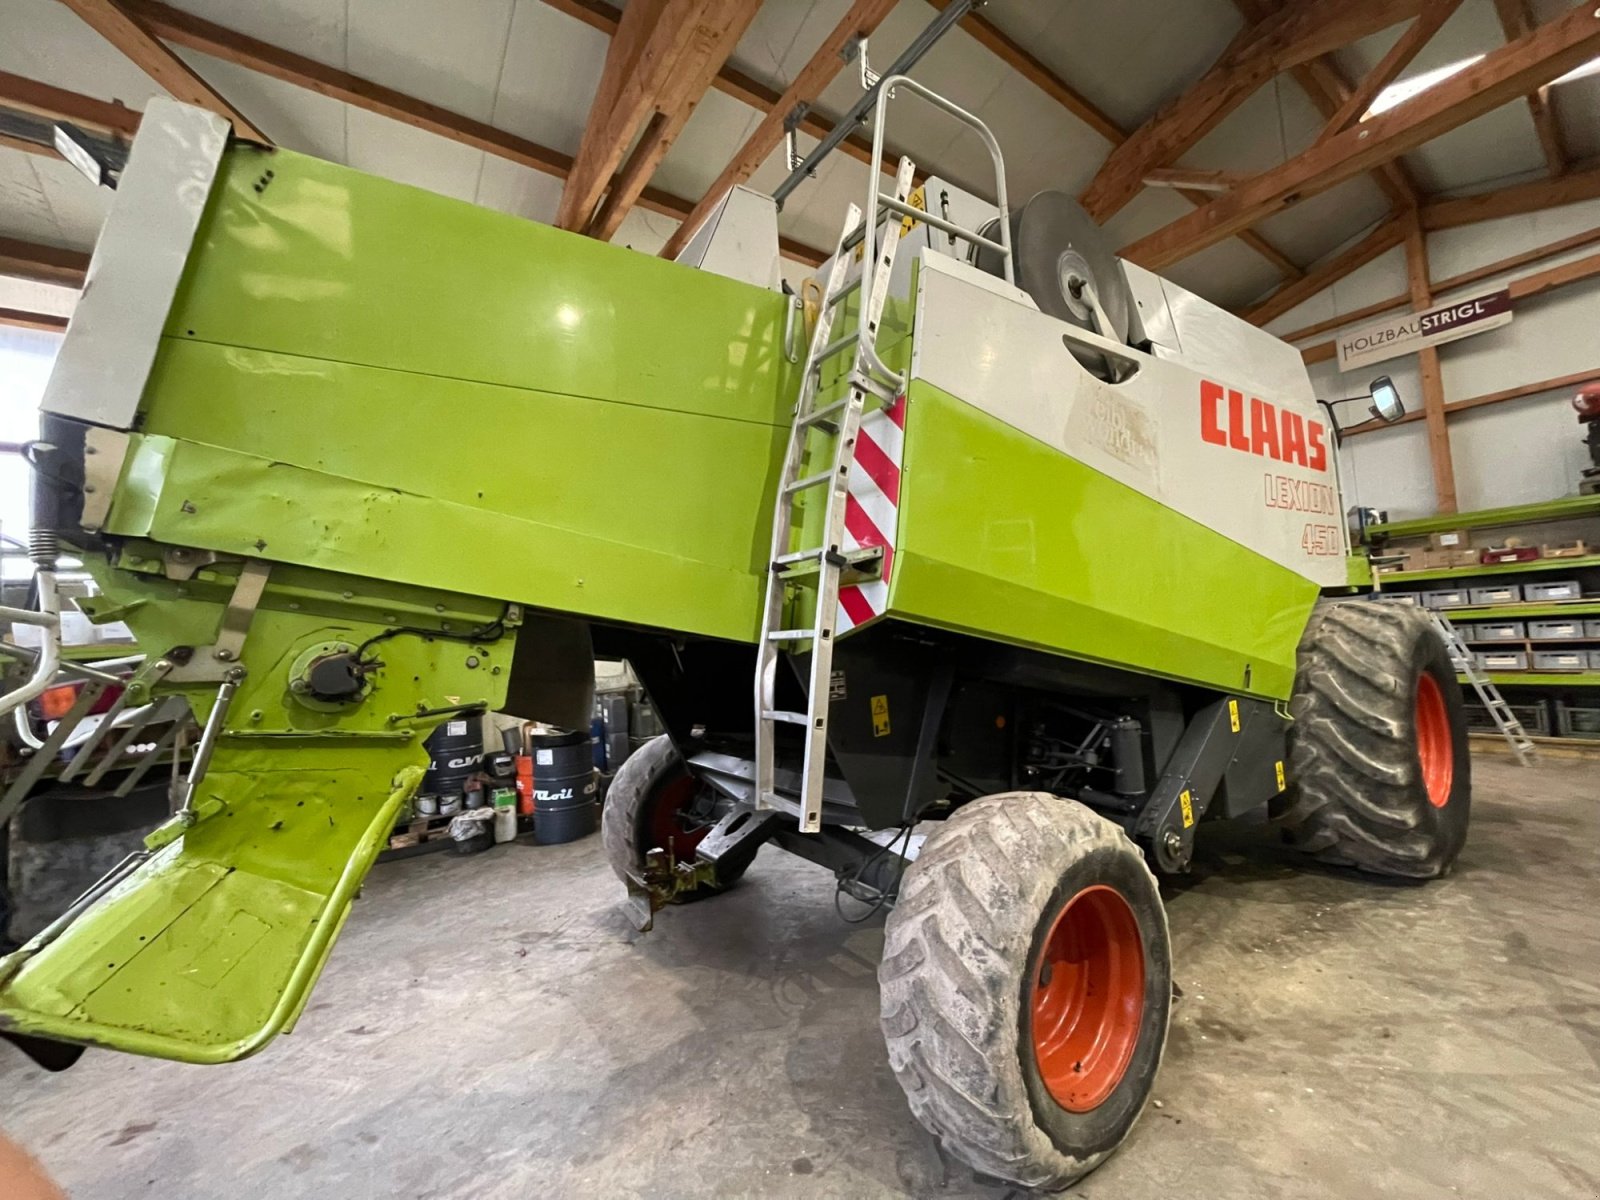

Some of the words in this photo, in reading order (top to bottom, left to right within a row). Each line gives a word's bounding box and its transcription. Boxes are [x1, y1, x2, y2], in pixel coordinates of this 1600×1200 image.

[1343, 320, 1421, 360] HOLZBAU
[1421, 302, 1485, 331] STRIGL
[1200, 379, 1327, 472] CLAAS
[1264, 473, 1335, 516] LEXION
[1302, 523, 1339, 556] 450
